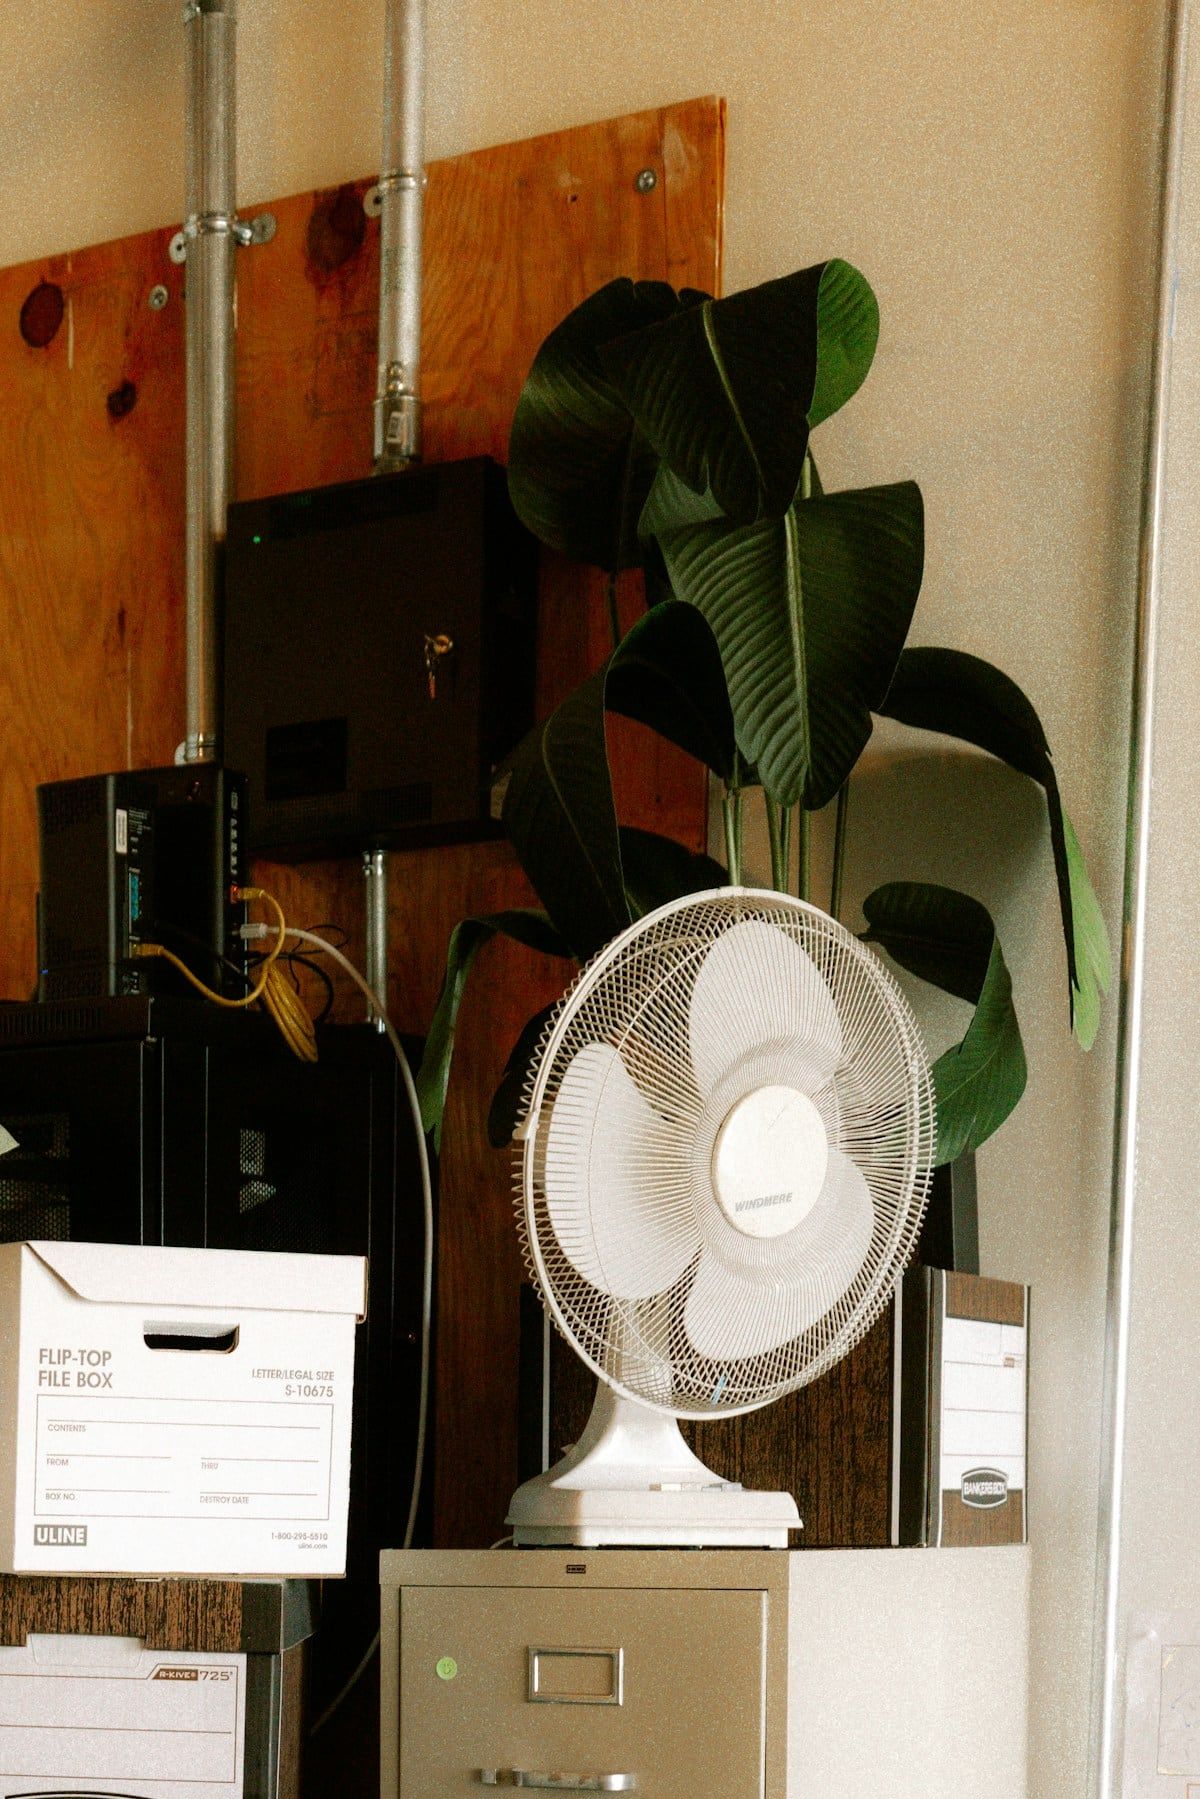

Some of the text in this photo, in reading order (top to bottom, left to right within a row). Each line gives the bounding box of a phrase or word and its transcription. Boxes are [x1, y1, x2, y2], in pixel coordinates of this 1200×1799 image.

[735, 1192, 793, 1213] WINDMERE
[39, 1348, 112, 1366] FLIP-TOP
[39, 1370, 113, 1389] FILE BOX
[252, 1368, 335, 1381] LETTER/LEGAL SIZE
[285, 1384, 334, 1397] S-10675
[47, 1424, 87, 1432] CONTENTS
[46, 1458, 69, 1466] FROM
[37, 1528, 85, 1545] ULINE
